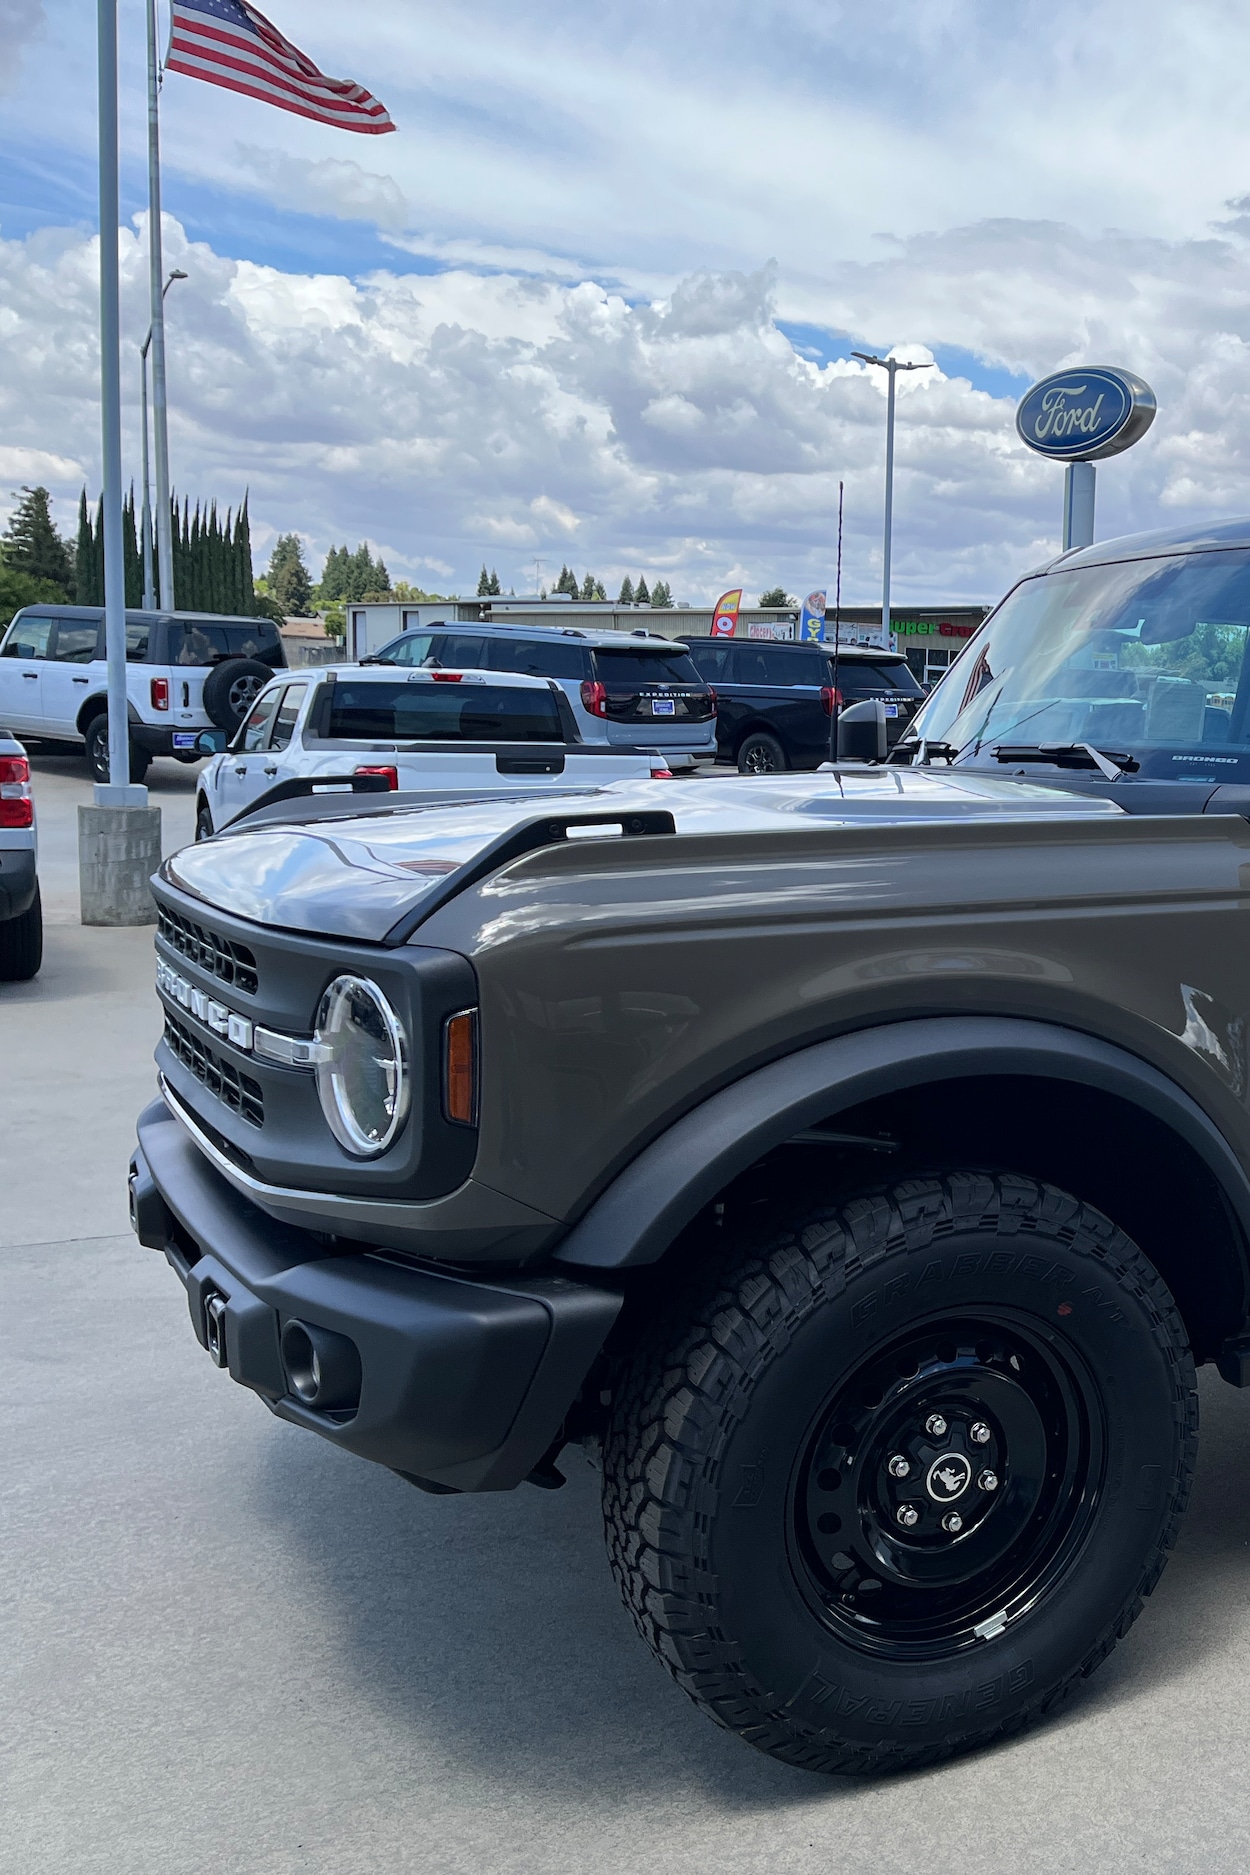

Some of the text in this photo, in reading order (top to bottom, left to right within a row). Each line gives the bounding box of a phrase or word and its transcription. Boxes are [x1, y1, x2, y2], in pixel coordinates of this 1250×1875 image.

[1034, 384, 1105, 439] Ford
[721, 603, 736, 611] NOW
[1171, 755, 1239, 764] BRONCO
[156, 955, 254, 1050] BRONCO
[849, 1250, 1077, 1330] GRABBER
[809, 1657, 1036, 1726] GENERAL
